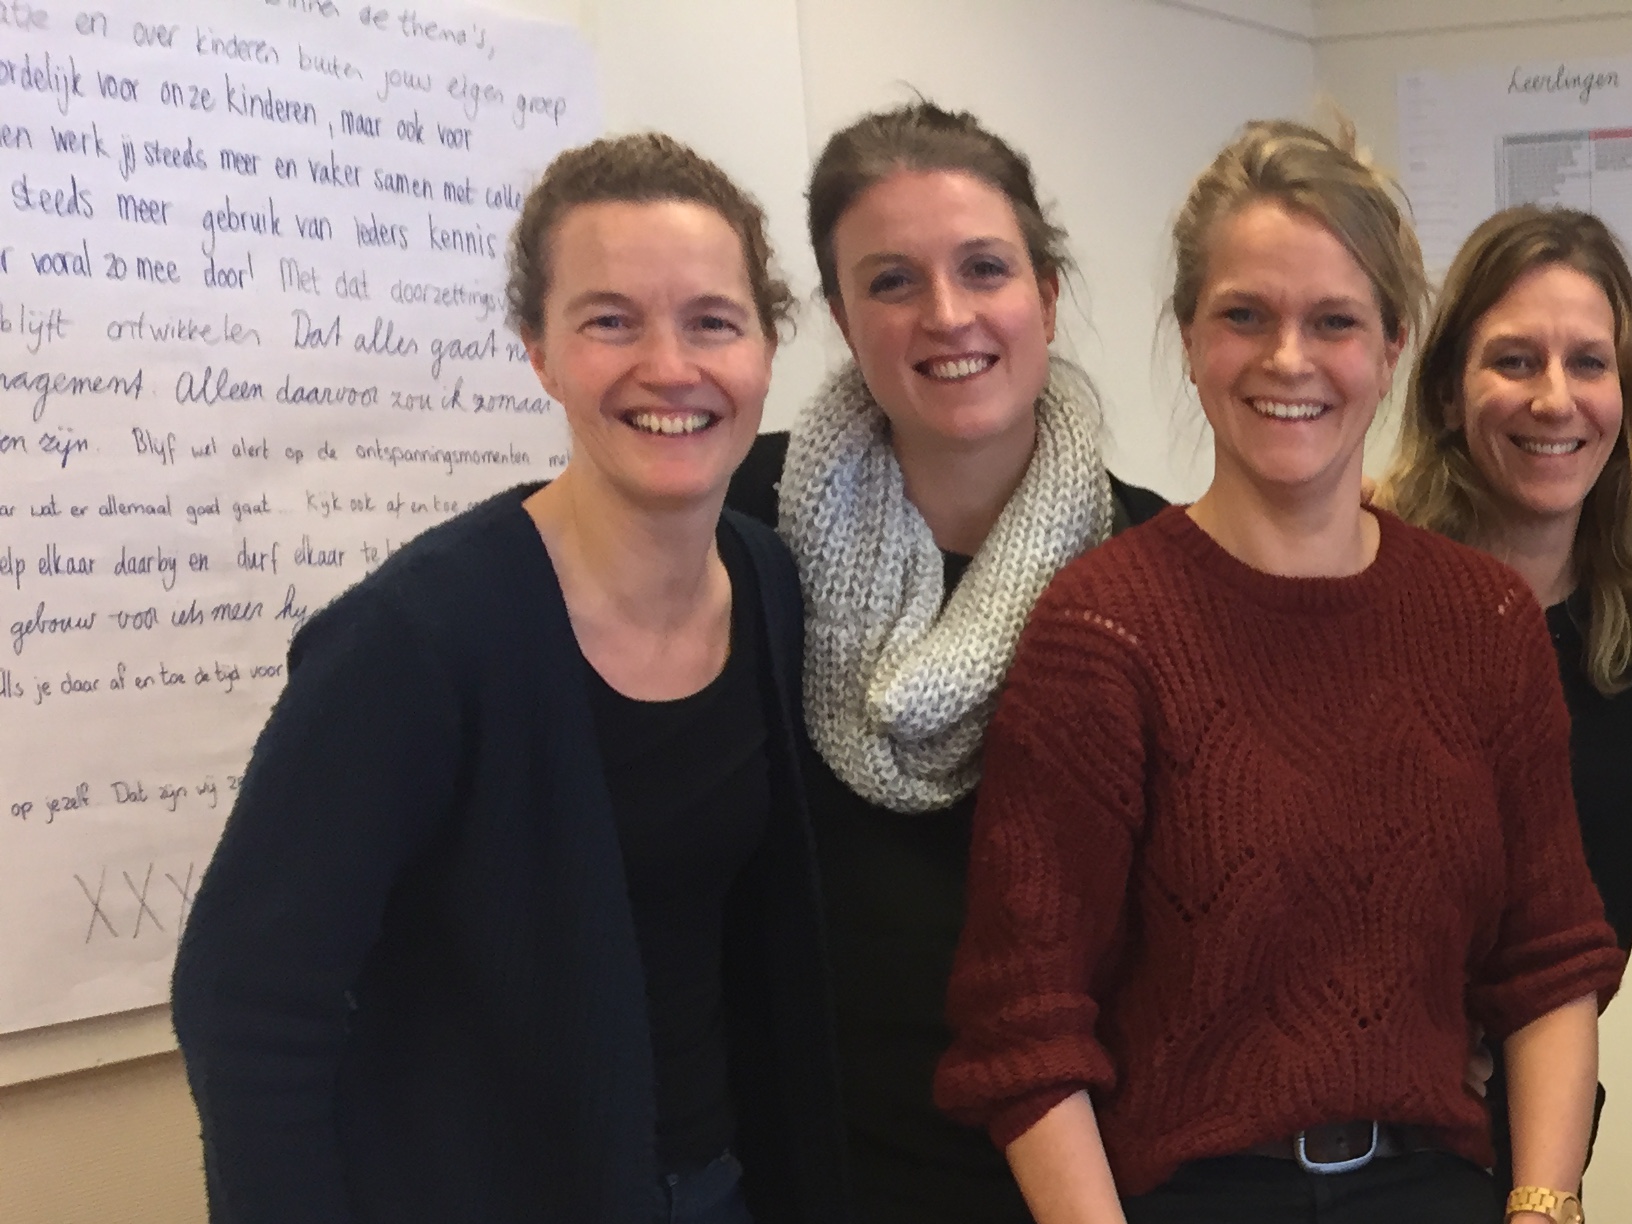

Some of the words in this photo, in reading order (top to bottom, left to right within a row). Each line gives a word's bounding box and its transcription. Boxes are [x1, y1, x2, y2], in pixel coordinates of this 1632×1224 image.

[359, 6, 389, 31] de
[75, 11, 107, 37] en
[133, 21, 179, 47] over
[196, 25, 279, 64] kinderen
[299, 42, 363, 81] buiten
[377, 69, 432, 103] jouw
[447, 73, 504, 122] eigen
[512, 93, 567, 130] groep
[1507, 63, 1619, 105] Leerlingen
[97, 70, 139, 102] voor
[160, 81, 216, 112] onze
[341, 109, 381, 137] maar
[396, 109, 425, 145] ook
[437, 121, 472, 151] voor
[51, 121, 110, 158] werk
[144, 137, 207, 170] steeds
[220, 149, 260, 176] meer
[275, 157, 297, 180] en
[308, 149, 361, 188] vaker
[374, 168, 433, 200] samen
[443, 177, 477, 206] met
[12, 174, 93, 219] steeds
[117, 193, 175, 225] meer
[202, 194, 281, 257] gebruik
[296, 214, 332, 240] van
[429, 211, 497, 260] kennis
[31, 238, 92, 277] vooral
[136, 256, 181, 283] mee
[279, 257, 320, 296] Met
[335, 269, 369, 300] dat
[107, 311, 260, 346] ontwikkelen
[291, 309, 341, 350] Dat
[431, 329, 497, 381] gaat
[275, 374, 378, 406] daarvoor
[390, 389, 432, 411] zou
[441, 376, 467, 411] ik
[473, 393, 551, 414] zomaar
[232, 437, 268, 459] alert
[285, 447, 303, 463] op
[317, 441, 338, 461] de
[31, 494, 62, 517] wat
[70, 505, 88, 518] er
[98, 494, 172, 517] allemaal
[350, 492, 375, 512] ook
[411, 501, 428, 513] en
[38, 543, 96, 577] elkaar
[189, 553, 209, 571] en
[237, 537, 279, 575] durf
[294, 534, 345, 566] elkaar
[361, 541, 379, 563] te
[10, 601, 96, 656] gebouw
[108, 607, 158, 630] voor
[211, 602, 264, 622] meer
[33, 676, 51, 706] je
[60, 670, 100, 694] daar
[110, 661, 126, 690] af
[135, 675, 155, 690] en
[160, 662, 186, 685] toe
[195, 667, 210, 685] de
[250, 664, 283, 678] voor
[11, 802, 32, 820] op
[111, 781, 148, 804] Dat
